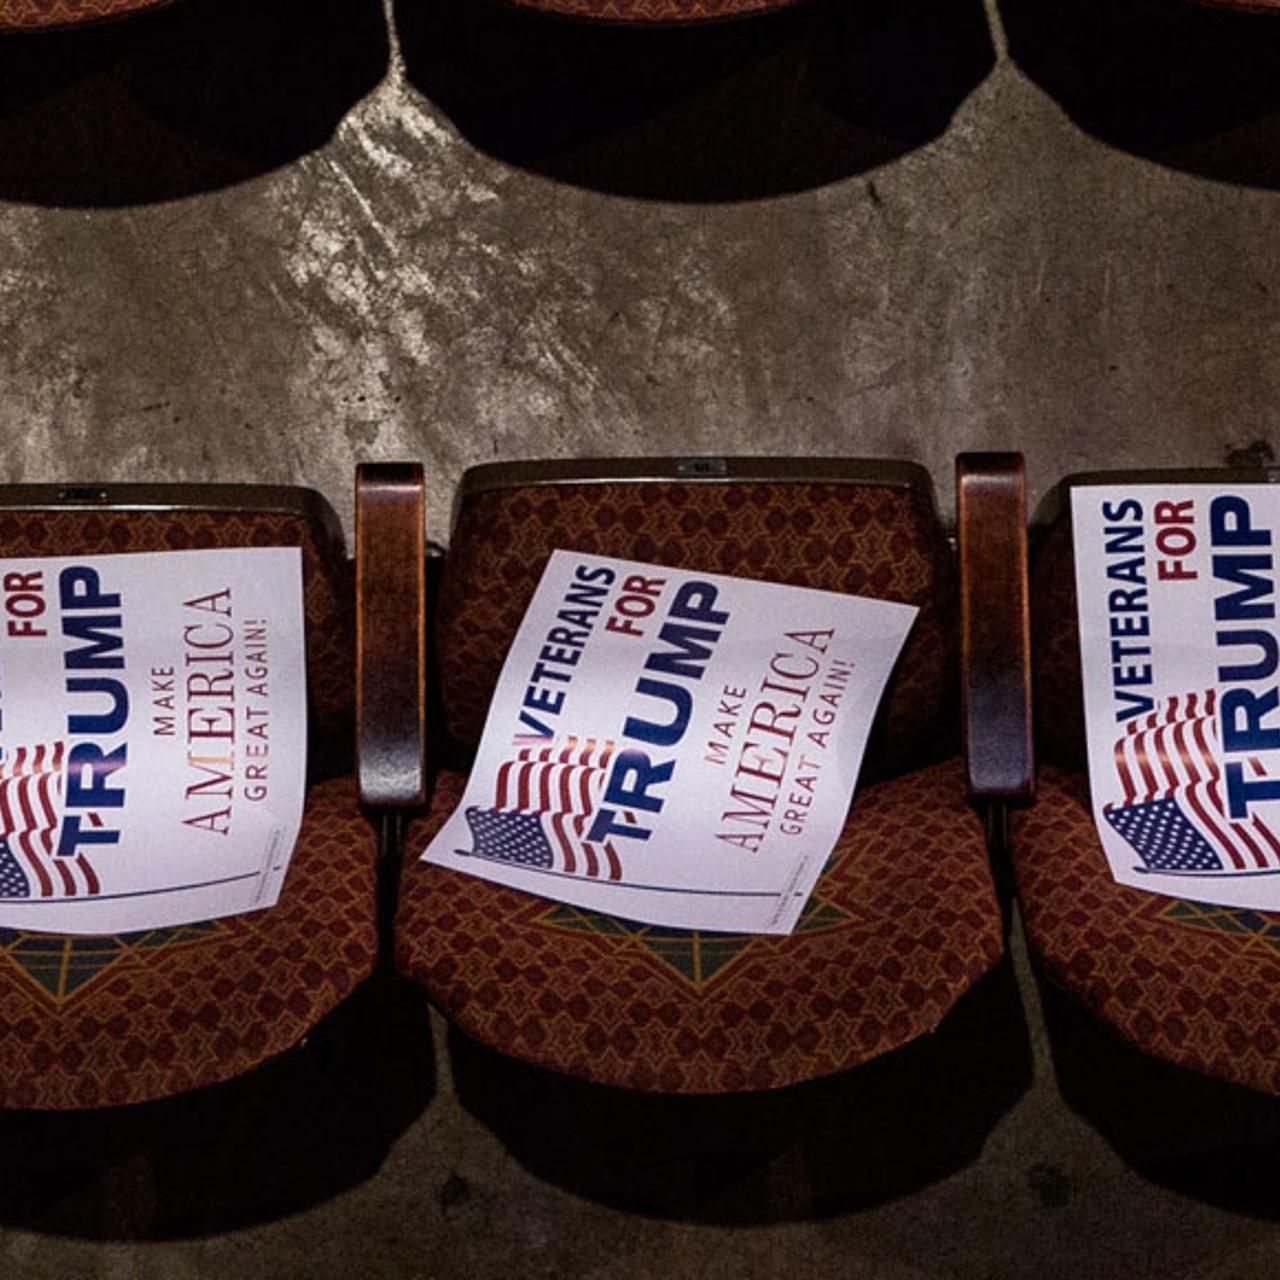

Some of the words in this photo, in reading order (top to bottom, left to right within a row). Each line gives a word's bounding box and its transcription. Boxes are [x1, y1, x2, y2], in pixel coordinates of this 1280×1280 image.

[4, 570, 47, 638] FOR
[605, 575, 666, 637] FOR
[1153, 499, 1197, 581] FOR
[244, 619, 269, 696] AGAIN!
[513, 564, 616, 746] VETERANS
[1102, 498, 1154, 722] VETERANS
[57, 565, 129, 857] TRUMP
[152, 666, 175, 736] MAKE
[183, 588, 236, 836] AMERICA
[244, 706, 269, 802] GREAT
[586, 580, 731, 843] TRUMP
[705, 685, 747, 765] MAKE
[715, 626, 836, 854] AMERICA
[779, 755, 822, 836] GREAT
[807, 659, 856, 748] AGAIN!
